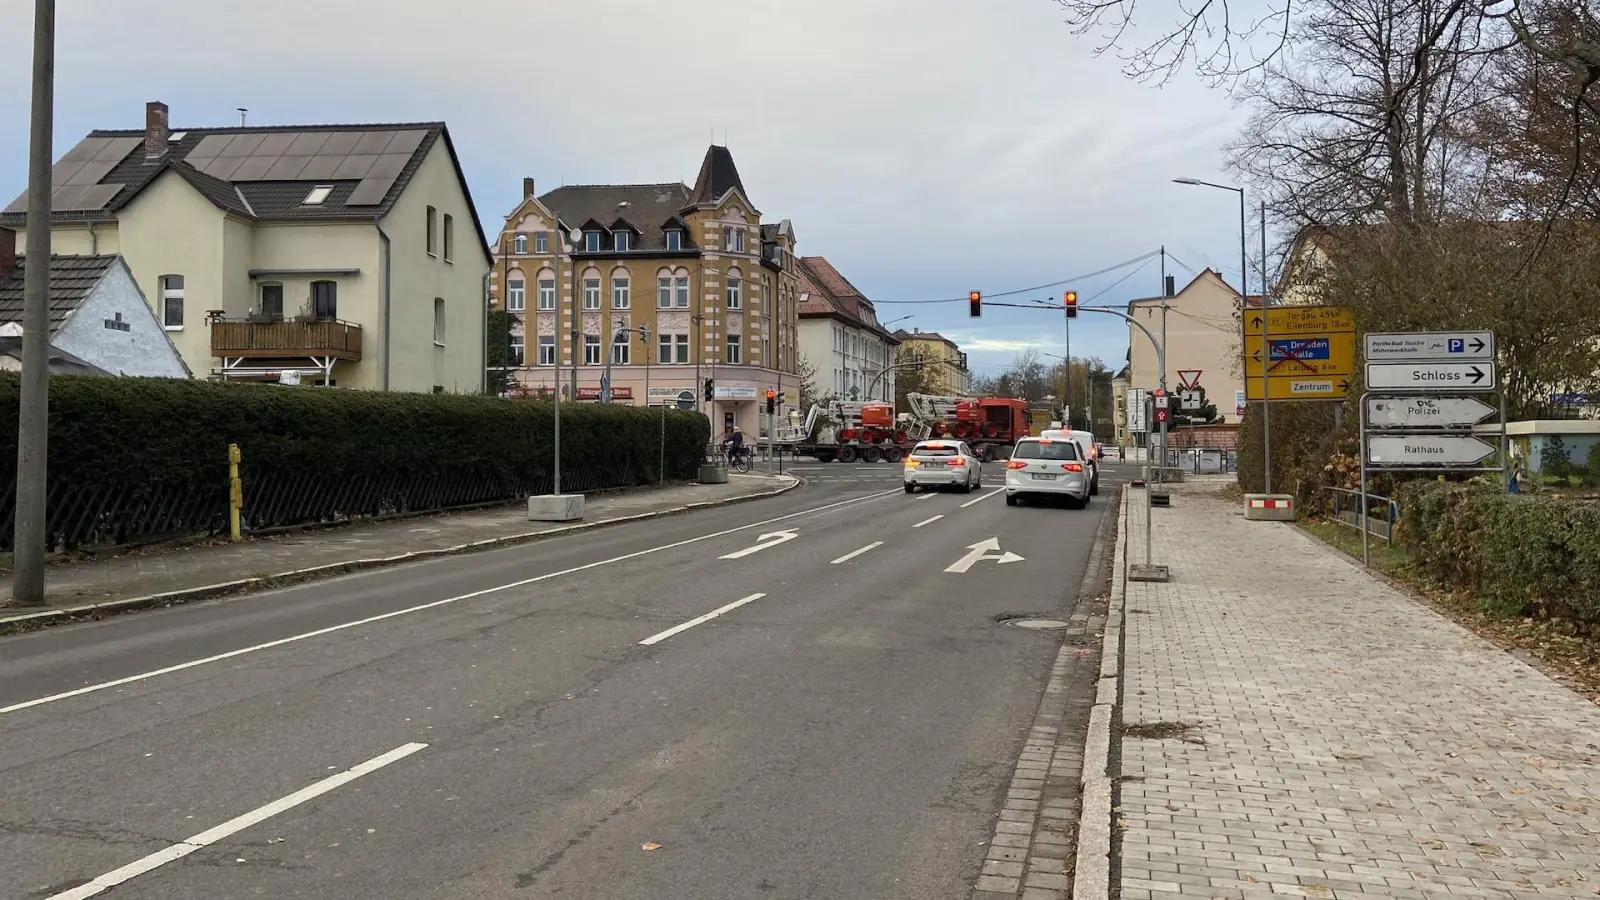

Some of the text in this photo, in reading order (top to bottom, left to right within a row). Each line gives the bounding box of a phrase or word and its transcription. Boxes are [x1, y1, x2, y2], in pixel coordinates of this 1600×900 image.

[1287, 312, 1316, 320] Torgau
[1286, 321, 1328, 330] Eilenburg
[1451, 340, 1461, 351] P
[1412, 370, 1460, 381] Schloss
[1293, 383, 1331, 391] Zentrum
[1417, 400, 1436, 408] DIE
[1408, 406, 1441, 415] Polizei
[1404, 445, 1445, 454] Rathaus
